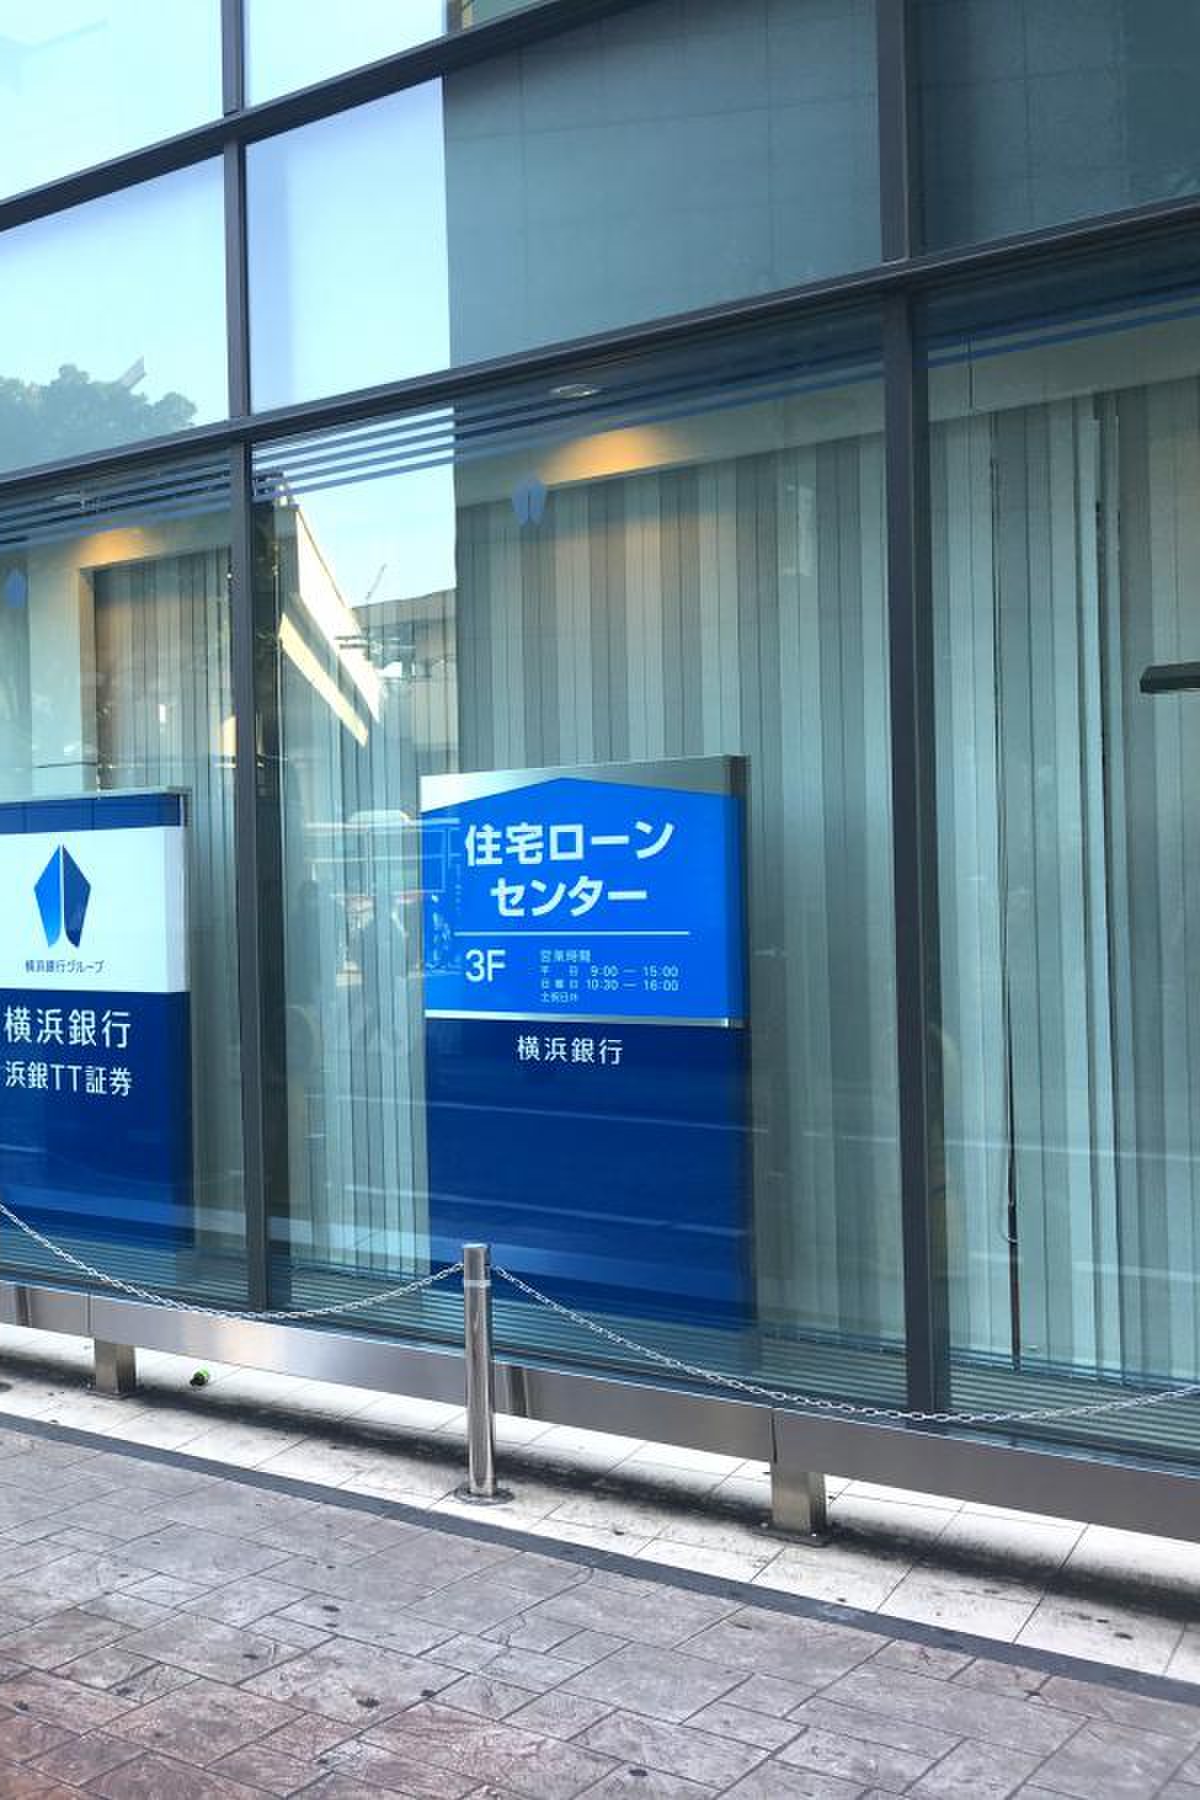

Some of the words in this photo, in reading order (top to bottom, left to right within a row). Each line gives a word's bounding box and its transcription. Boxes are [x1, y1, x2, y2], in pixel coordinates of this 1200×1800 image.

[464, 821, 675, 867] 住宅ローン
[490, 875, 648, 918] センター
[25, 959, 105, 974] 横浜銀行グループ
[465, 949, 506, 983] 3F
[539, 950, 592, 964] 営業時間
[3, 1005, 133, 1049] 横浜銀行
[516, 1035, 624, 1065] 横浜銀行
[5, 1060, 133, 1097] 浜銀TT証券
